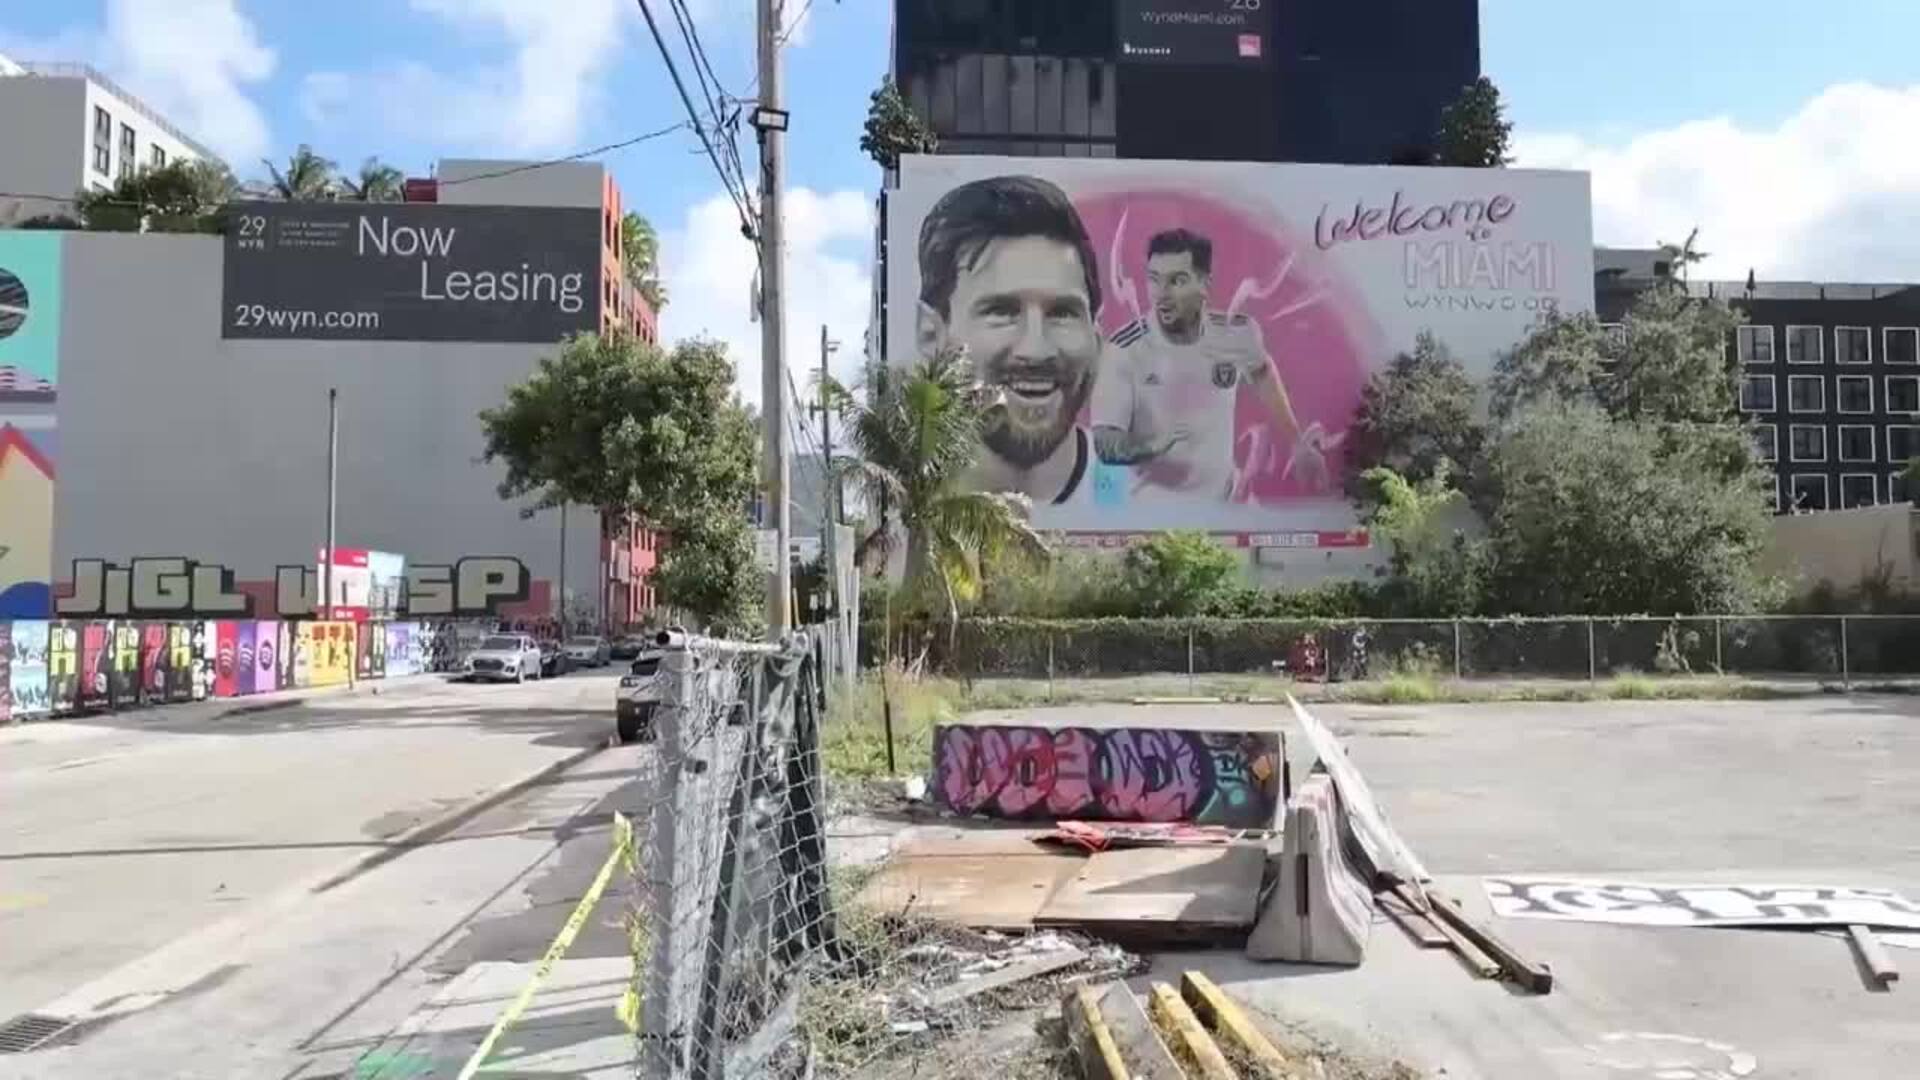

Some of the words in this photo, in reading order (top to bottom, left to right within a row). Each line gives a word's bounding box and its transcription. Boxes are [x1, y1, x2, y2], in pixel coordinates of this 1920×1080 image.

[239, 215, 267, 236] 29
[357, 216, 455, 256] Now
[1314, 187, 1516, 250] Welcome
[421, 260, 583, 313] Leasing
[1403, 240, 1557, 290] MIAMI
[235, 304, 380, 332] 29wyn.com
